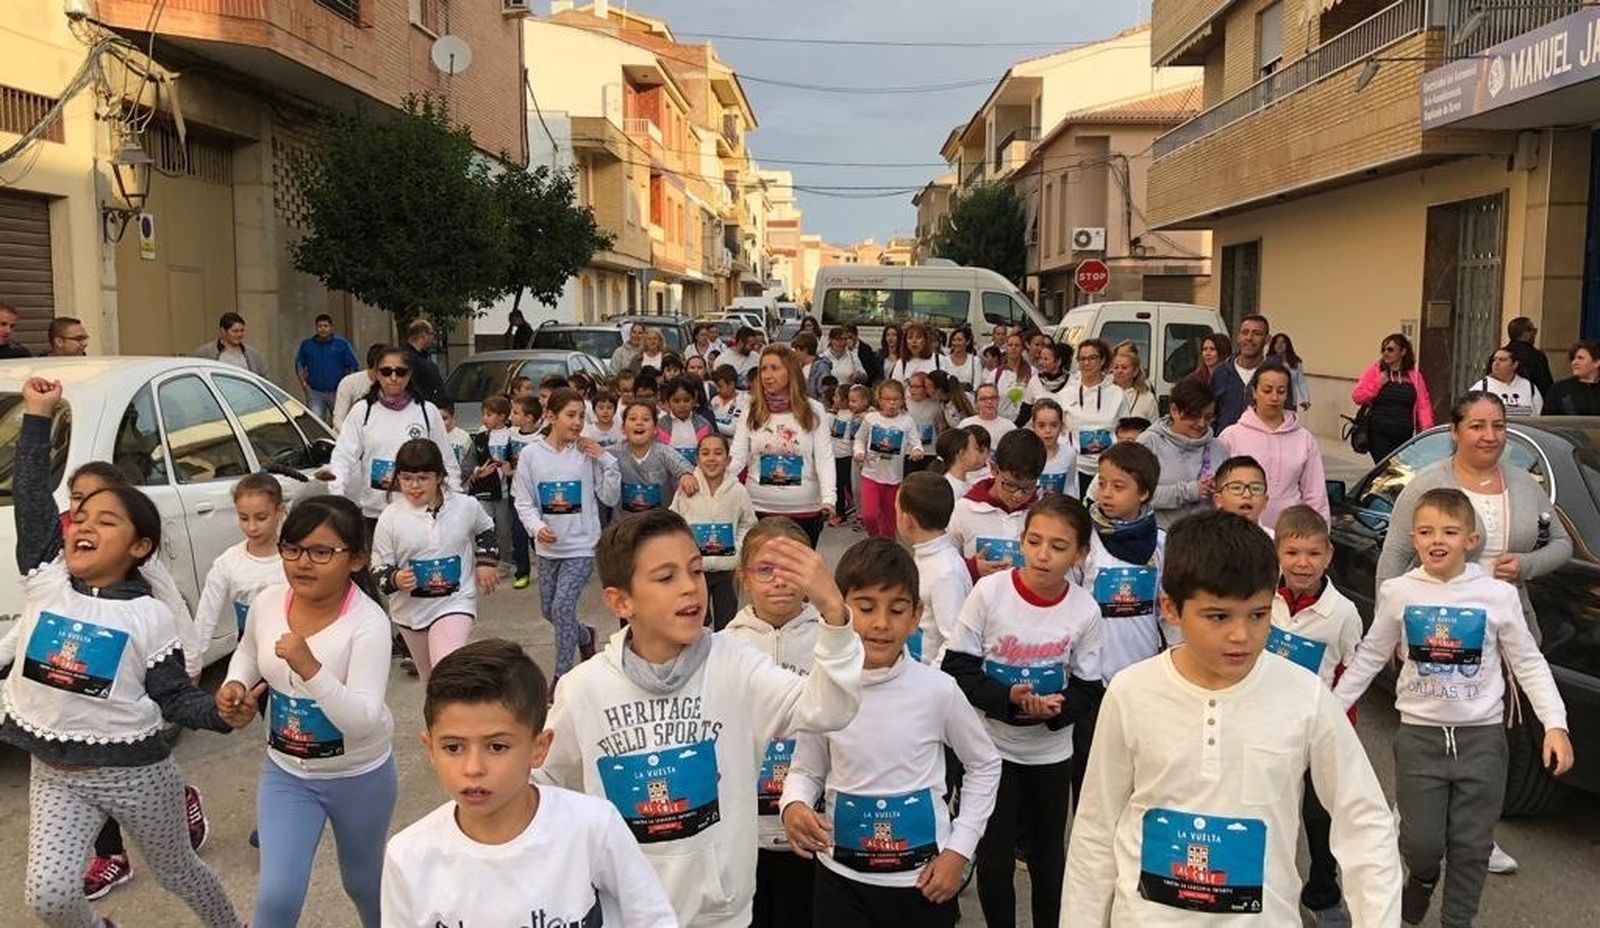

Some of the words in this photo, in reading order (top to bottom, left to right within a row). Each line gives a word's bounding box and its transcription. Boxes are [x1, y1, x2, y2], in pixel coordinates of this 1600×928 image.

[1510, 31, 1572, 91] MANUEL
[1080, 272, 1106, 281] STOP
[604, 696, 701, 731] HERITAGE
[597, 727, 647, 757] FIELD
[654, 720, 723, 747] SPORTS
[647, 766, 676, 777] VUELTA
[1177, 829, 1187, 838] LA
[1190, 832, 1222, 843] VUELTA
